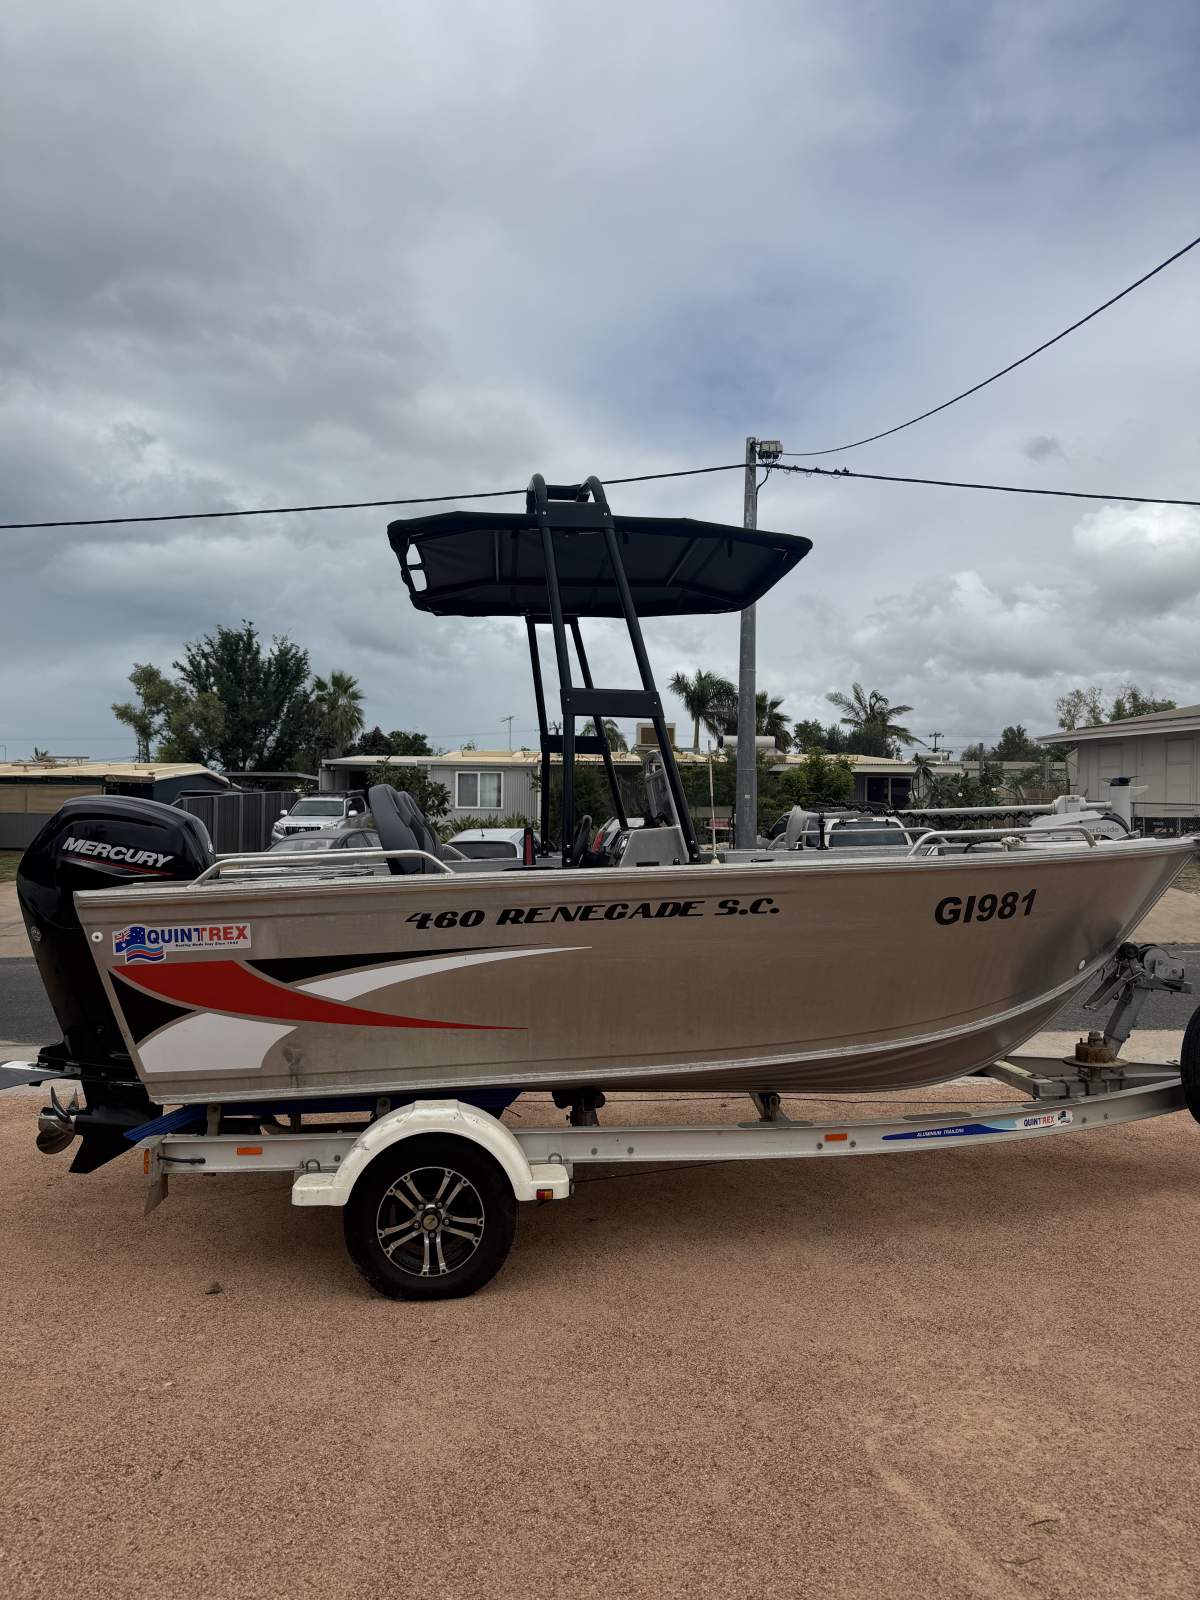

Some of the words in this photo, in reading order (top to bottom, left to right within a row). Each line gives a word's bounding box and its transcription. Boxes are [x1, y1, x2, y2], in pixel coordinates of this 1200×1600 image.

[62, 837, 175, 868] MERCURY
[404, 909, 486, 930] 460
[495, 900, 706, 926] RENEGADE
[713, 897, 780, 916] S.C.
[934, 888, 1037, 925] GI981
[146, 925, 249, 945] QUINTREX
[1023, 1115, 1055, 1127] QUINTREX
